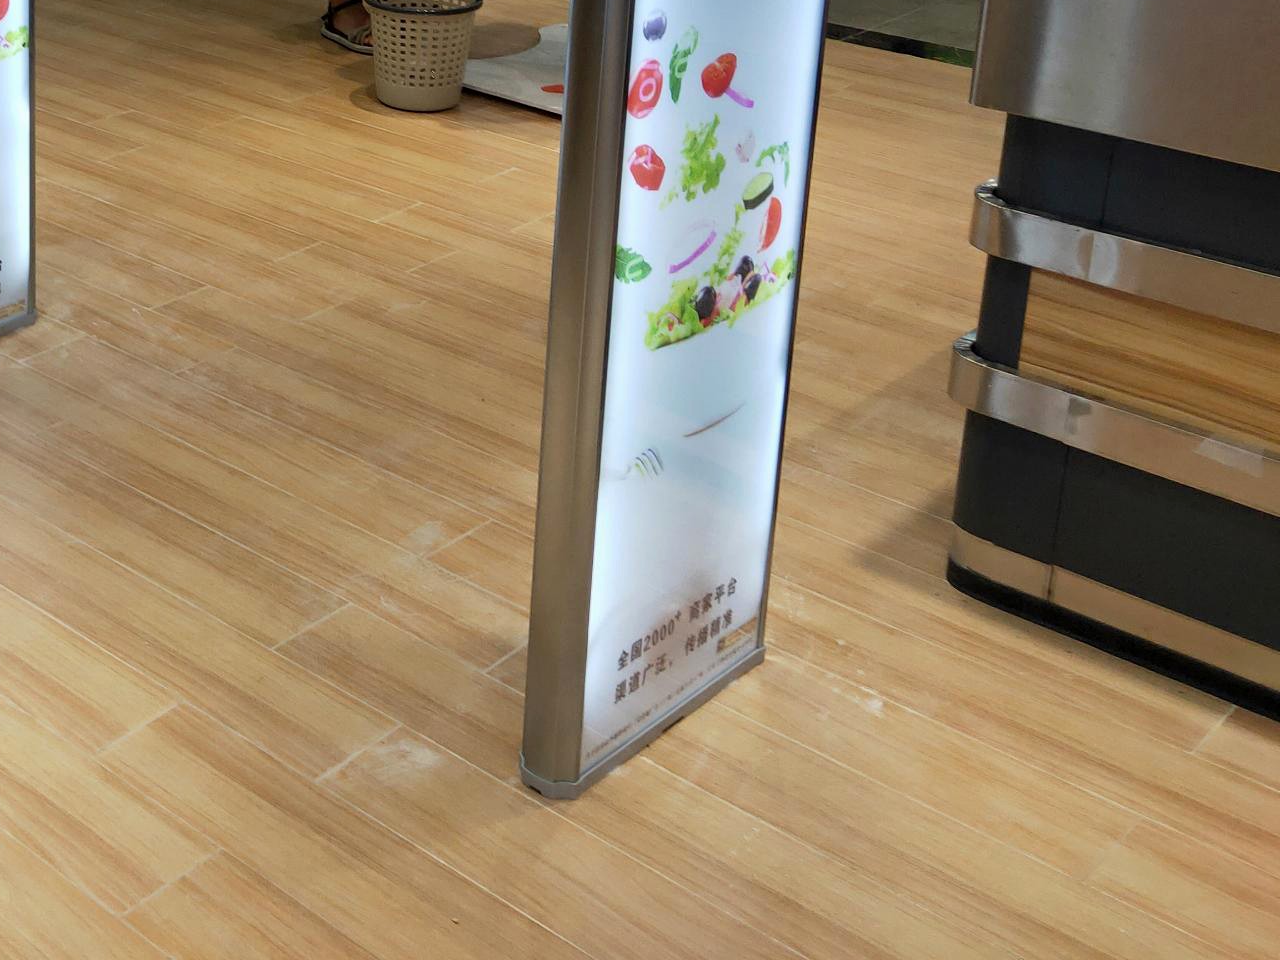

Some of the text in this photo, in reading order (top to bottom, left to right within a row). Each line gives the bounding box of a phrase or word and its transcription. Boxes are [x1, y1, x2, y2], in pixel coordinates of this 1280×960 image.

[687, 576, 738, 623] 商家平台
[684, 608, 734, 657] 传播精准
